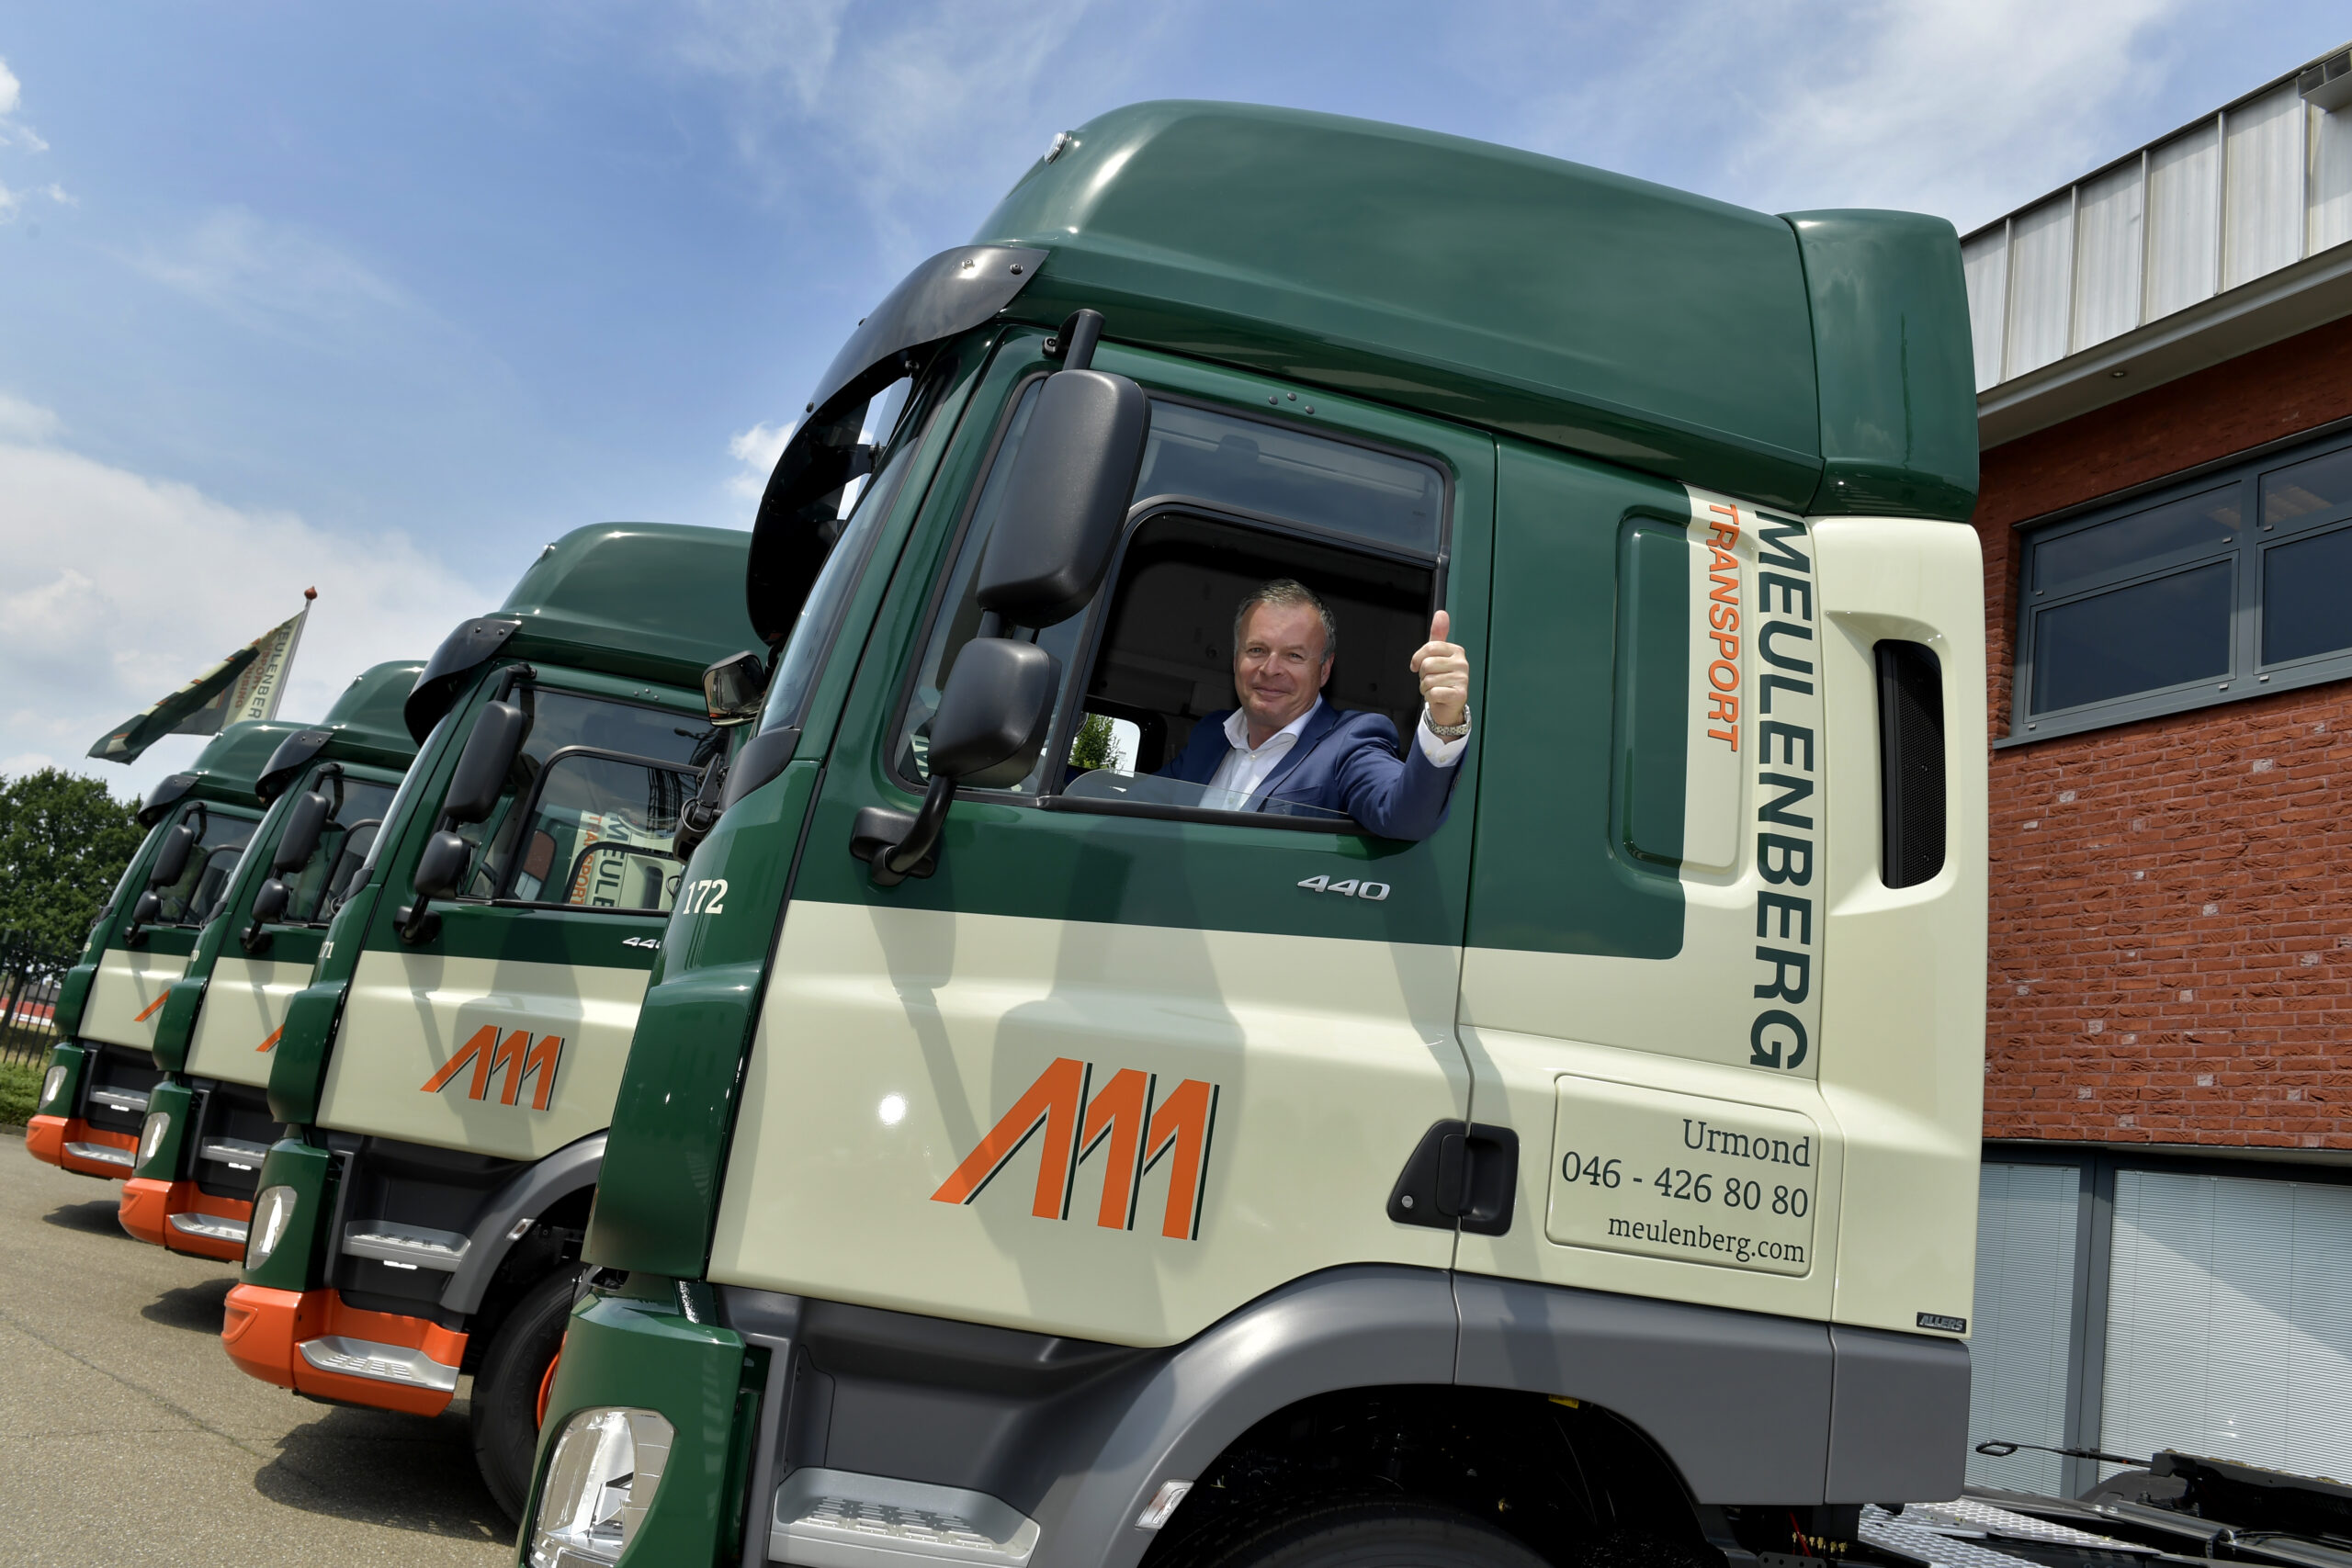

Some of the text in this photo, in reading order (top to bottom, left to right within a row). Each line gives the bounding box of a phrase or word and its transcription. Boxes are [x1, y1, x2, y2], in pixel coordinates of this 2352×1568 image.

[1707, 503, 1741, 751] TRANSPORT
[248, 624, 291, 719] EULENBER
[1749, 509, 1814, 1070] MEULENBERG
[592, 817, 629, 907] MEULE
[1296, 874, 1391, 901] 440
[683, 878, 729, 915] 172
[1682, 1118, 1811, 1168] Urmond
[1562, 1151, 1622, 1189] 046
[1654, 1167, 1713, 1203] 426
[1724, 1178, 1761, 1211] 80
[1771, 1185, 1808, 1218] 80
[1608, 1217, 1805, 1263] meulenberg.com
[1918, 1314, 1964, 1332] ALLERS
